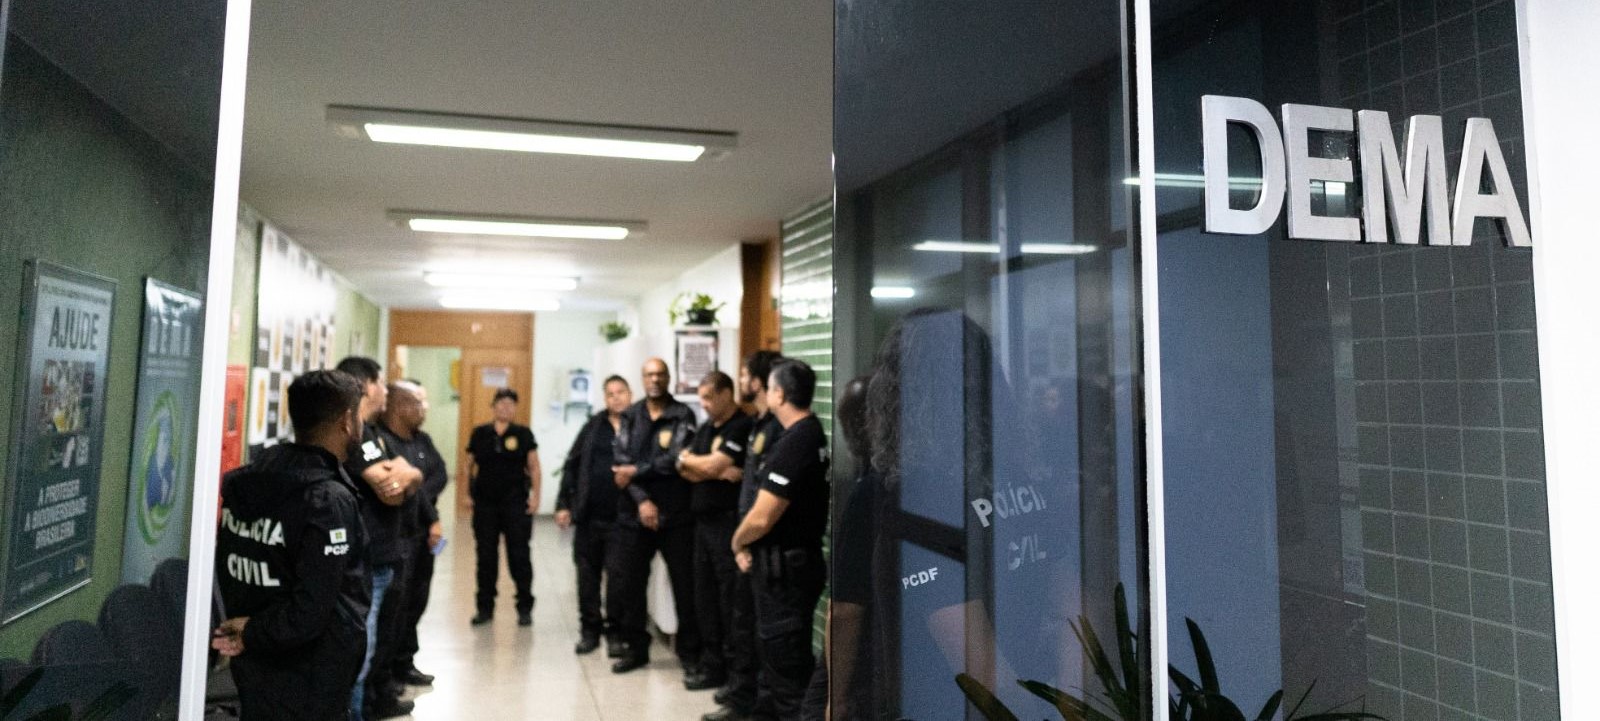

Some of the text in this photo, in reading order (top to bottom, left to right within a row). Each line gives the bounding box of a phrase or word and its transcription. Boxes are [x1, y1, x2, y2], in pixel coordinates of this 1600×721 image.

[1201, 94, 1533, 247] DEMA
[48, 306, 100, 350] AJUDE
[227, 553, 280, 587] CIVIL
[902, 567, 939, 589] PCDF
